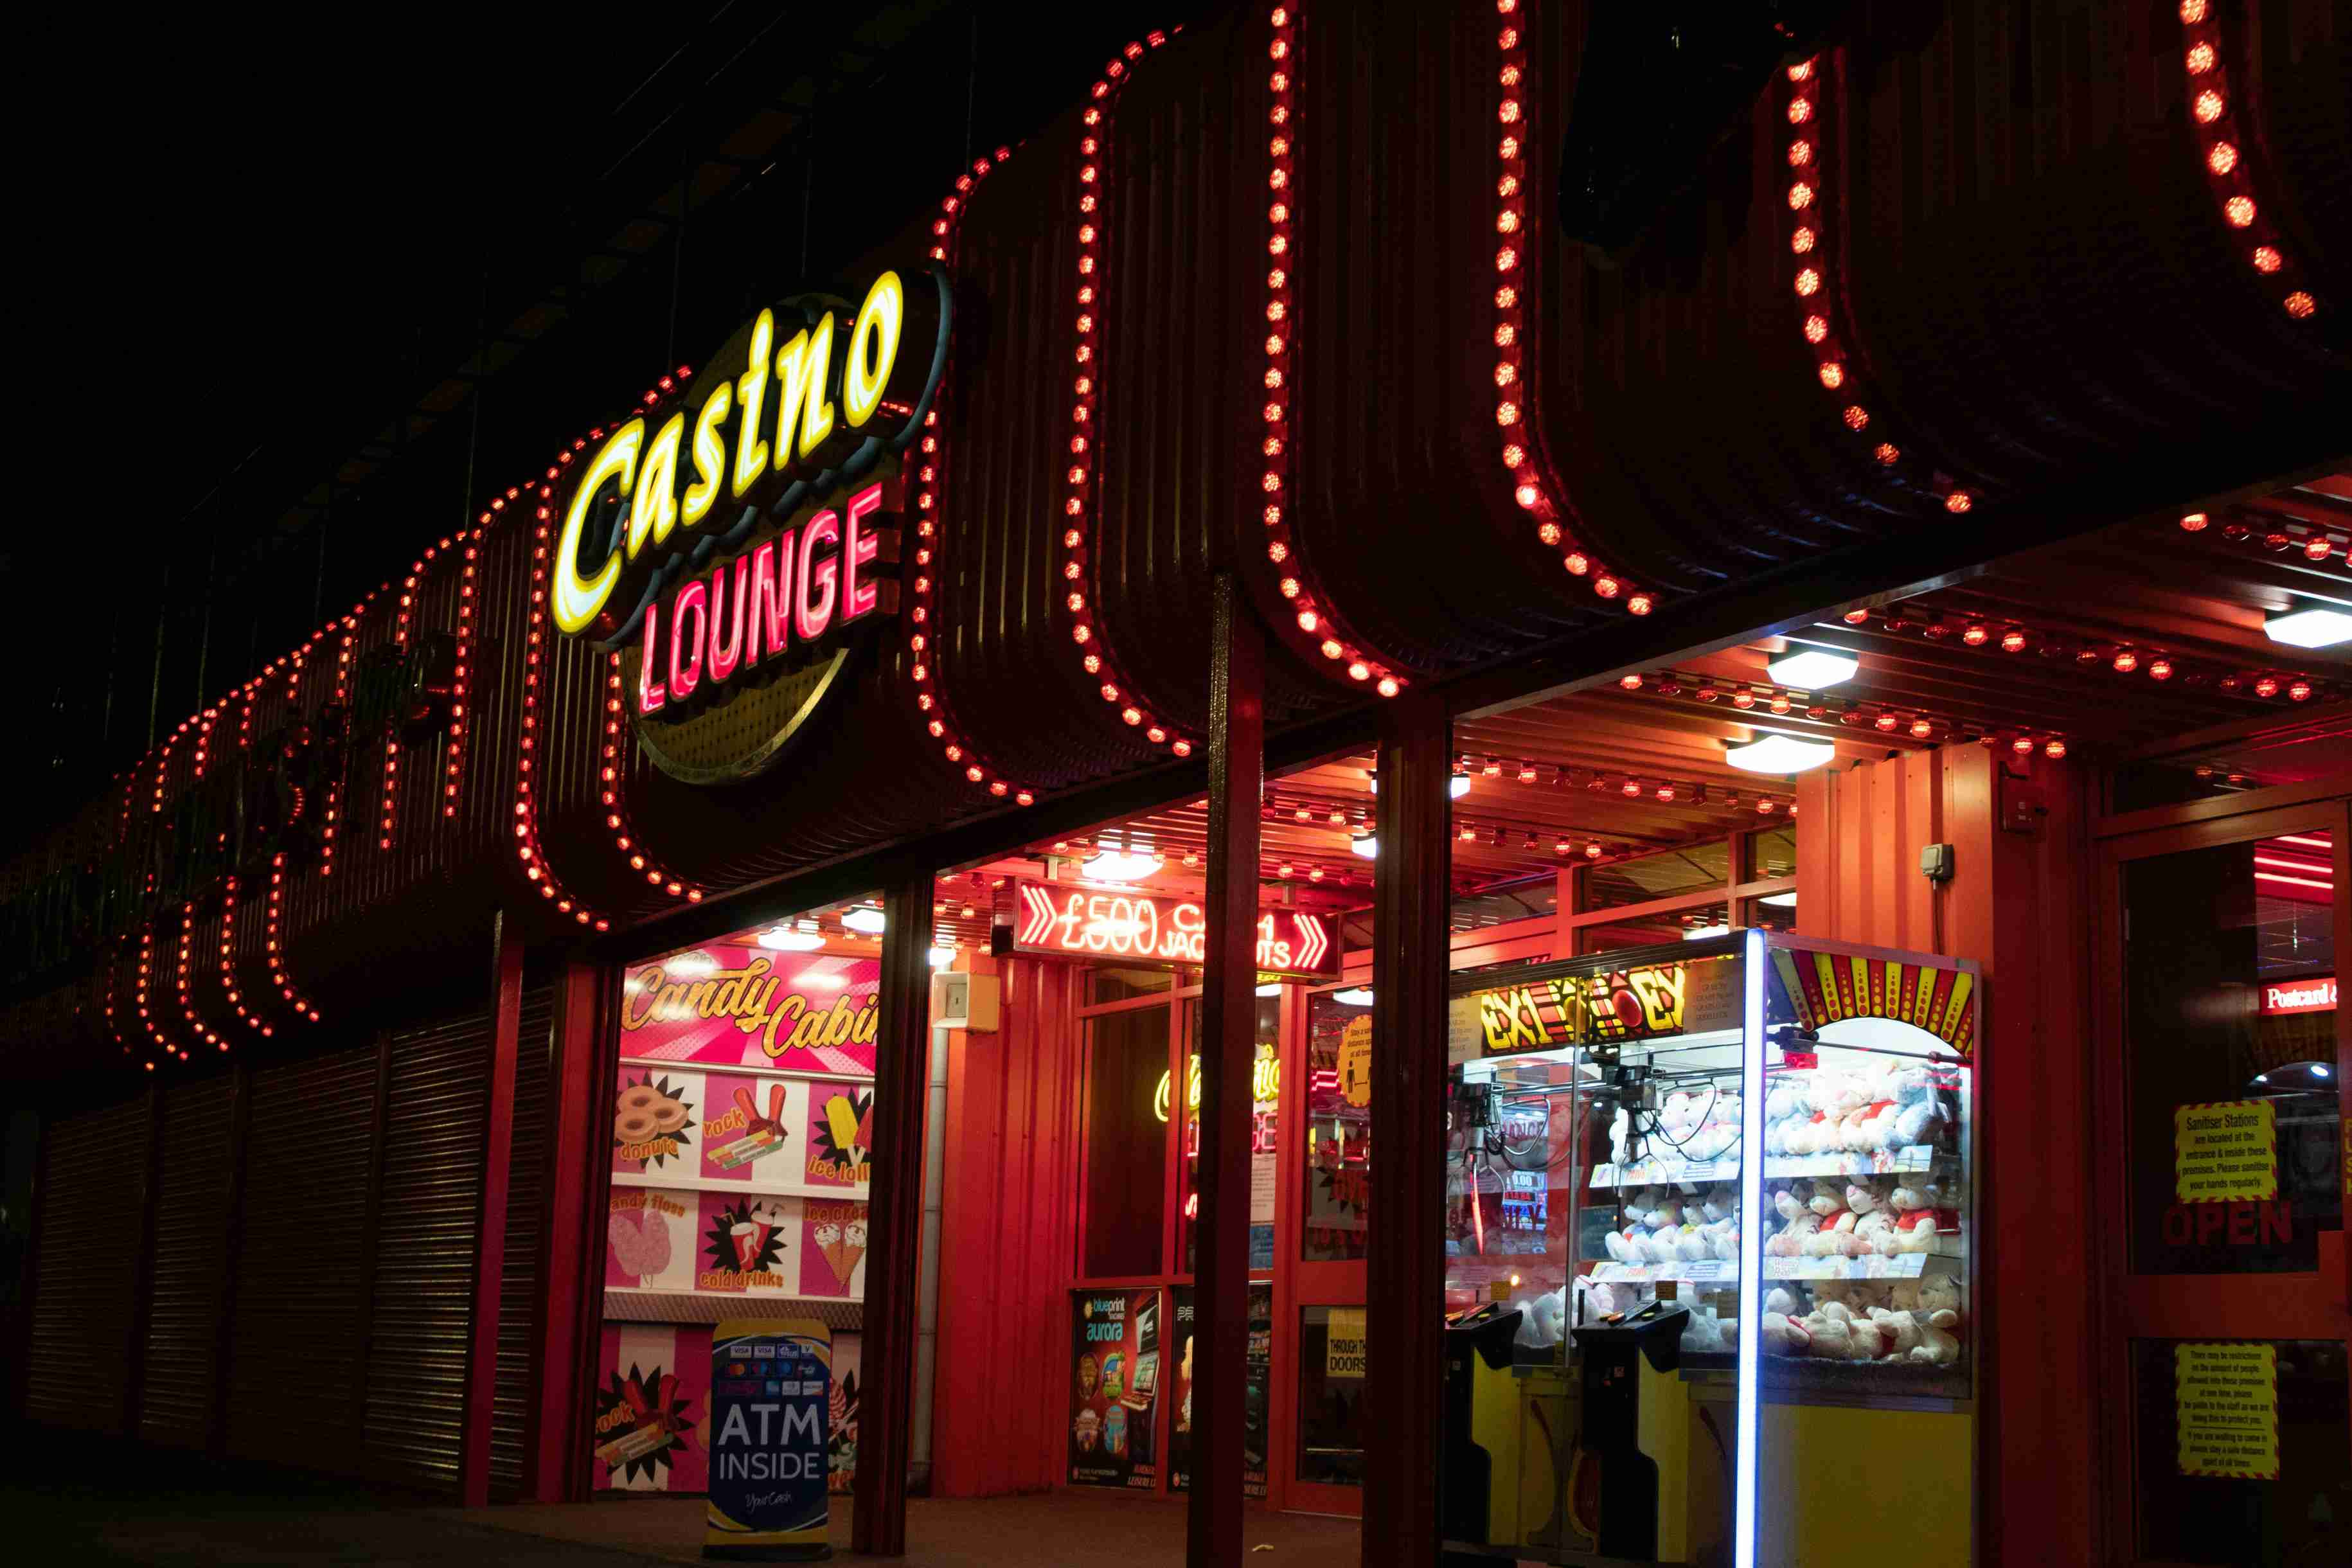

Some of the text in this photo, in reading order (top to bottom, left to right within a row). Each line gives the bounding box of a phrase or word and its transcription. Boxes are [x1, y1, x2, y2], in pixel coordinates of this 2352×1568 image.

[551, 269, 904, 634] Casino
[639, 482, 884, 715] LOUNGE
[1058, 894, 1157, 954] £500
[621, 957, 780, 1033] Candy
[2267, 983, 2330, 1009] Postcard
[703, 1107, 746, 1137] rock
[2186, 1114, 2259, 1132] Sanitiser Stations
[2207, 1134, 2232, 1143] located
[2234, 1133, 2241, 1141] at
[2243, 1132, 2255, 1141] the
[620, 1137, 679, 1161] donuts
[2247, 1146, 2267, 1155] these
[807, 1154, 870, 1183] ice loll
[2217, 1163, 2240, 1173] Please
[2189, 1181, 2205, 1191] your
[2206, 1180, 2227, 1189] hands
[610, 1192, 646, 1213] andy
[803, 1202, 830, 1223] ice
[2162, 1200, 2294, 1245] OPEN
[700, 1271, 784, 1289] cold drinks
[1094, 1296, 1125, 1315] blueprint
[1086, 1323, 1123, 1342] aurora
[1330, 1357, 1368, 1373] DOORS
[718, 1403, 821, 1446] ATM
[719, 1452, 821, 1481] INSIDE
